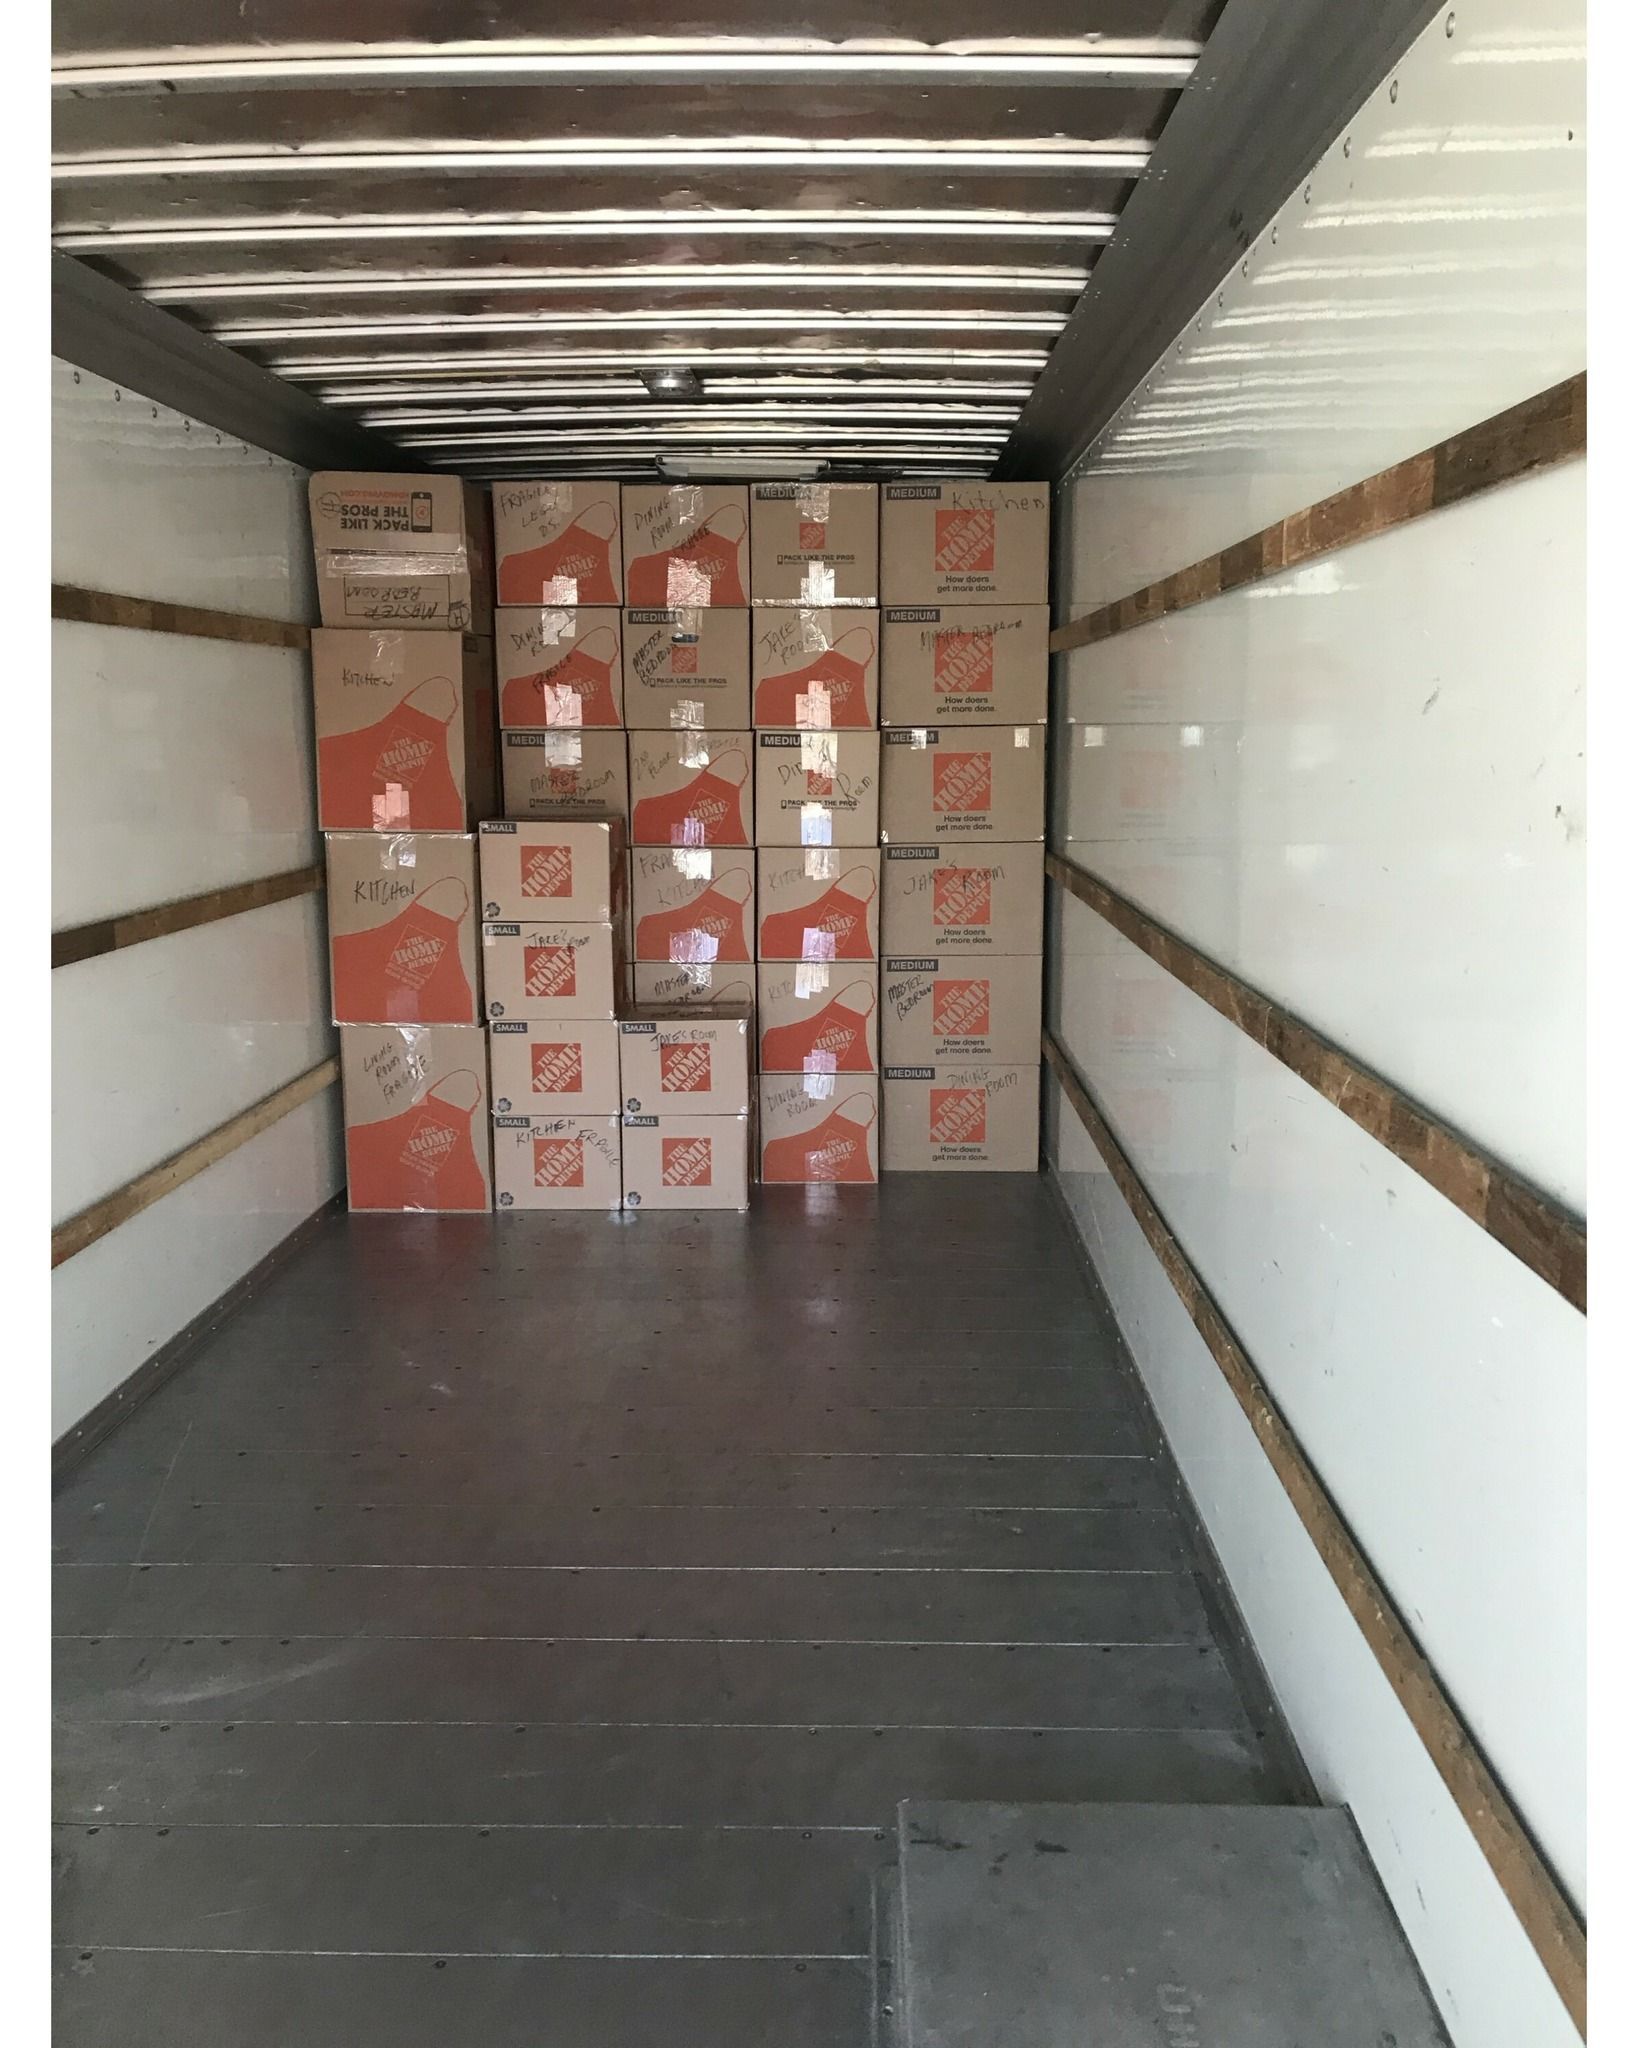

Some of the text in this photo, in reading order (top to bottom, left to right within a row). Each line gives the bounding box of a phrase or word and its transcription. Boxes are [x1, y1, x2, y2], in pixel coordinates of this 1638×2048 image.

[891, 488, 937, 497] MEDIUM
[341, 505, 378, 516] PROS
[384, 506, 408, 517] THE
[341, 518, 409, 531] PACK LIKE
[942, 517, 967, 540] THE
[936, 510, 994, 571] HOME
[959, 534, 994, 571] DEPOT
[891, 611, 936, 620] MEDIUM
[935, 632, 992, 692] HOME
[941, 639, 965, 662] THE
[958, 656, 992, 692] DEPOT
[765, 736, 801, 745] MEDIU
[890, 733, 934, 742] MEDM
[933, 753, 991, 811] HOME
[940, 760, 964, 782] THE
[957, 776, 991, 811] DEPOT
[527, 852, 548, 871] THE
[891, 849, 935, 858] MEDIUM
[521, 846, 572, 897] HOME
[541, 866, 572, 897] DEPOT
[354, 879, 415, 905] KITCHEN
[933, 868, 990, 925] HOME
[940, 875, 964, 897] THE
[956, 891, 990, 925] DEPOT
[405, 936, 424, 946] THE
[489, 926, 516, 934] SMALL
[394, 939, 442, 964] HOME
[408, 955, 439, 969] DEPOT
[530, 952, 551, 971] THE
[524, 946, 576, 996] HOME
[891, 961, 934, 970] MEDIUM
[545, 966, 576, 996] DEPOT
[933, 980, 989, 1035] HOME
[939, 987, 963, 1008] THE
[625, 1024, 654, 1032] SMALL
[955, 1002, 989, 1035] DEPOT
[531, 1043, 582, 1092] HOME
[537, 1049, 558, 1068] THE
[661, 1043, 711, 1092] HOME
[666, 1049, 687, 1067] THE
[551, 1063, 582, 1092] DEPOT
[681, 1063, 711, 1092] DEPOT
[888, 1069, 931, 1078] MEDIUM
[930, 1089, 986, 1142] HOME
[936, 1095, 959, 1116] THE
[516, 1119, 575, 1149] KITCHEN
[952, 1110, 986, 1142] DEPOT
[409, 1128, 457, 1152] HOME
[534, 1139, 584, 1187] HOME
[539, 1145, 560, 1163] THE
[662, 1138, 711, 1186] HOME
[668, 1144, 688, 1162] THE
[554, 1158, 584, 1187] DEPOT
[682, 1157, 711, 1186] DEPOT
